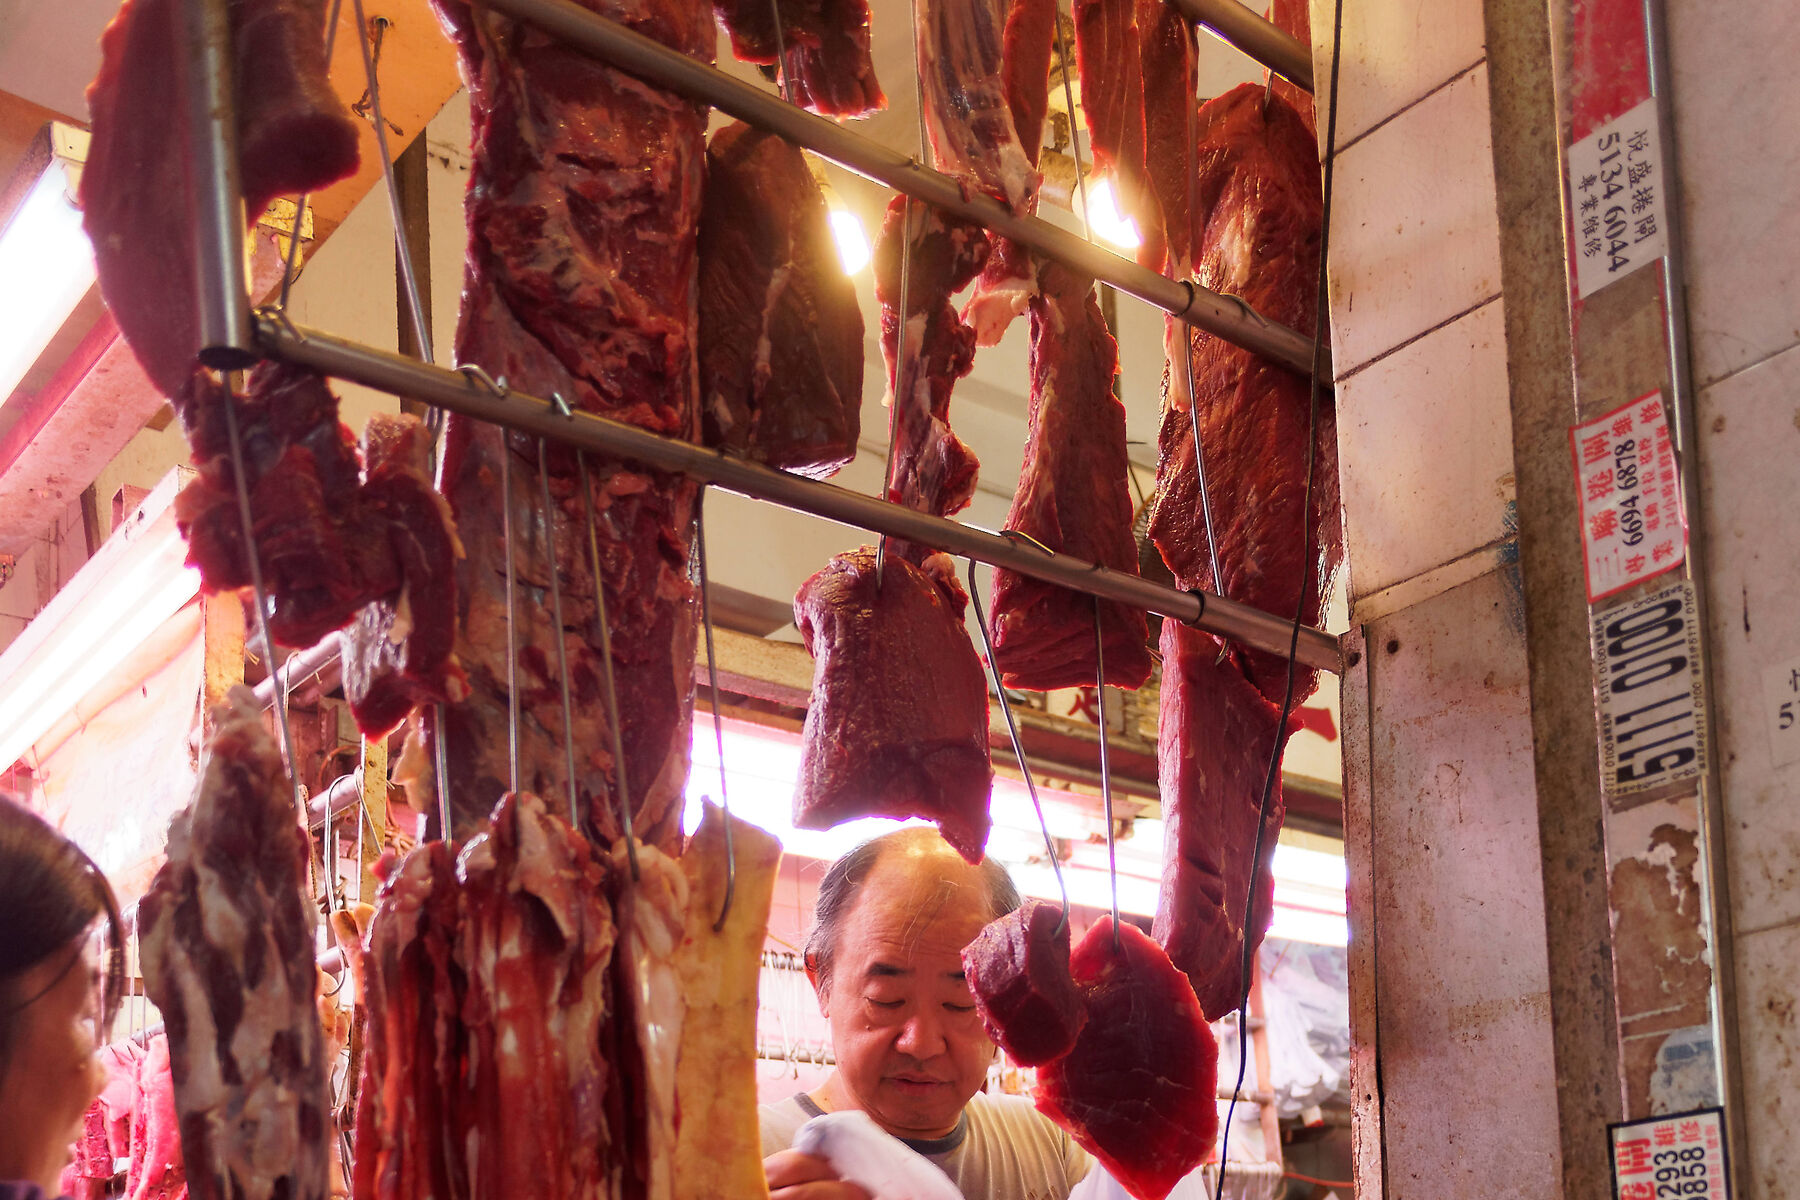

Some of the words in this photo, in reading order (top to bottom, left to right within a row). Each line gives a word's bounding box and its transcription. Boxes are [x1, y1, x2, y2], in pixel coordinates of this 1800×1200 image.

[1598, 132, 1625, 200] 5134
[1578, 173, 1603, 258] 專業維修
[1603, 206, 1630, 273] 6044
[1611, 400, 1662, 438] 維修
[1614, 439, 1638, 491] 6878
[1581, 430, 1621, 582] 三聯捲閘
[1619, 495, 1645, 547] 6694
[1624, 540, 1674, 575] 專業
[1683, 587, 1695, 614] 0100
[1596, 648, 1608, 674] 0100
[1606, 599, 1687, 694] 0100
[1603, 742, 1615, 768] 0100
[1615, 692, 1695, 782] 5111
[1655, 1120, 1703, 1147] 維修
